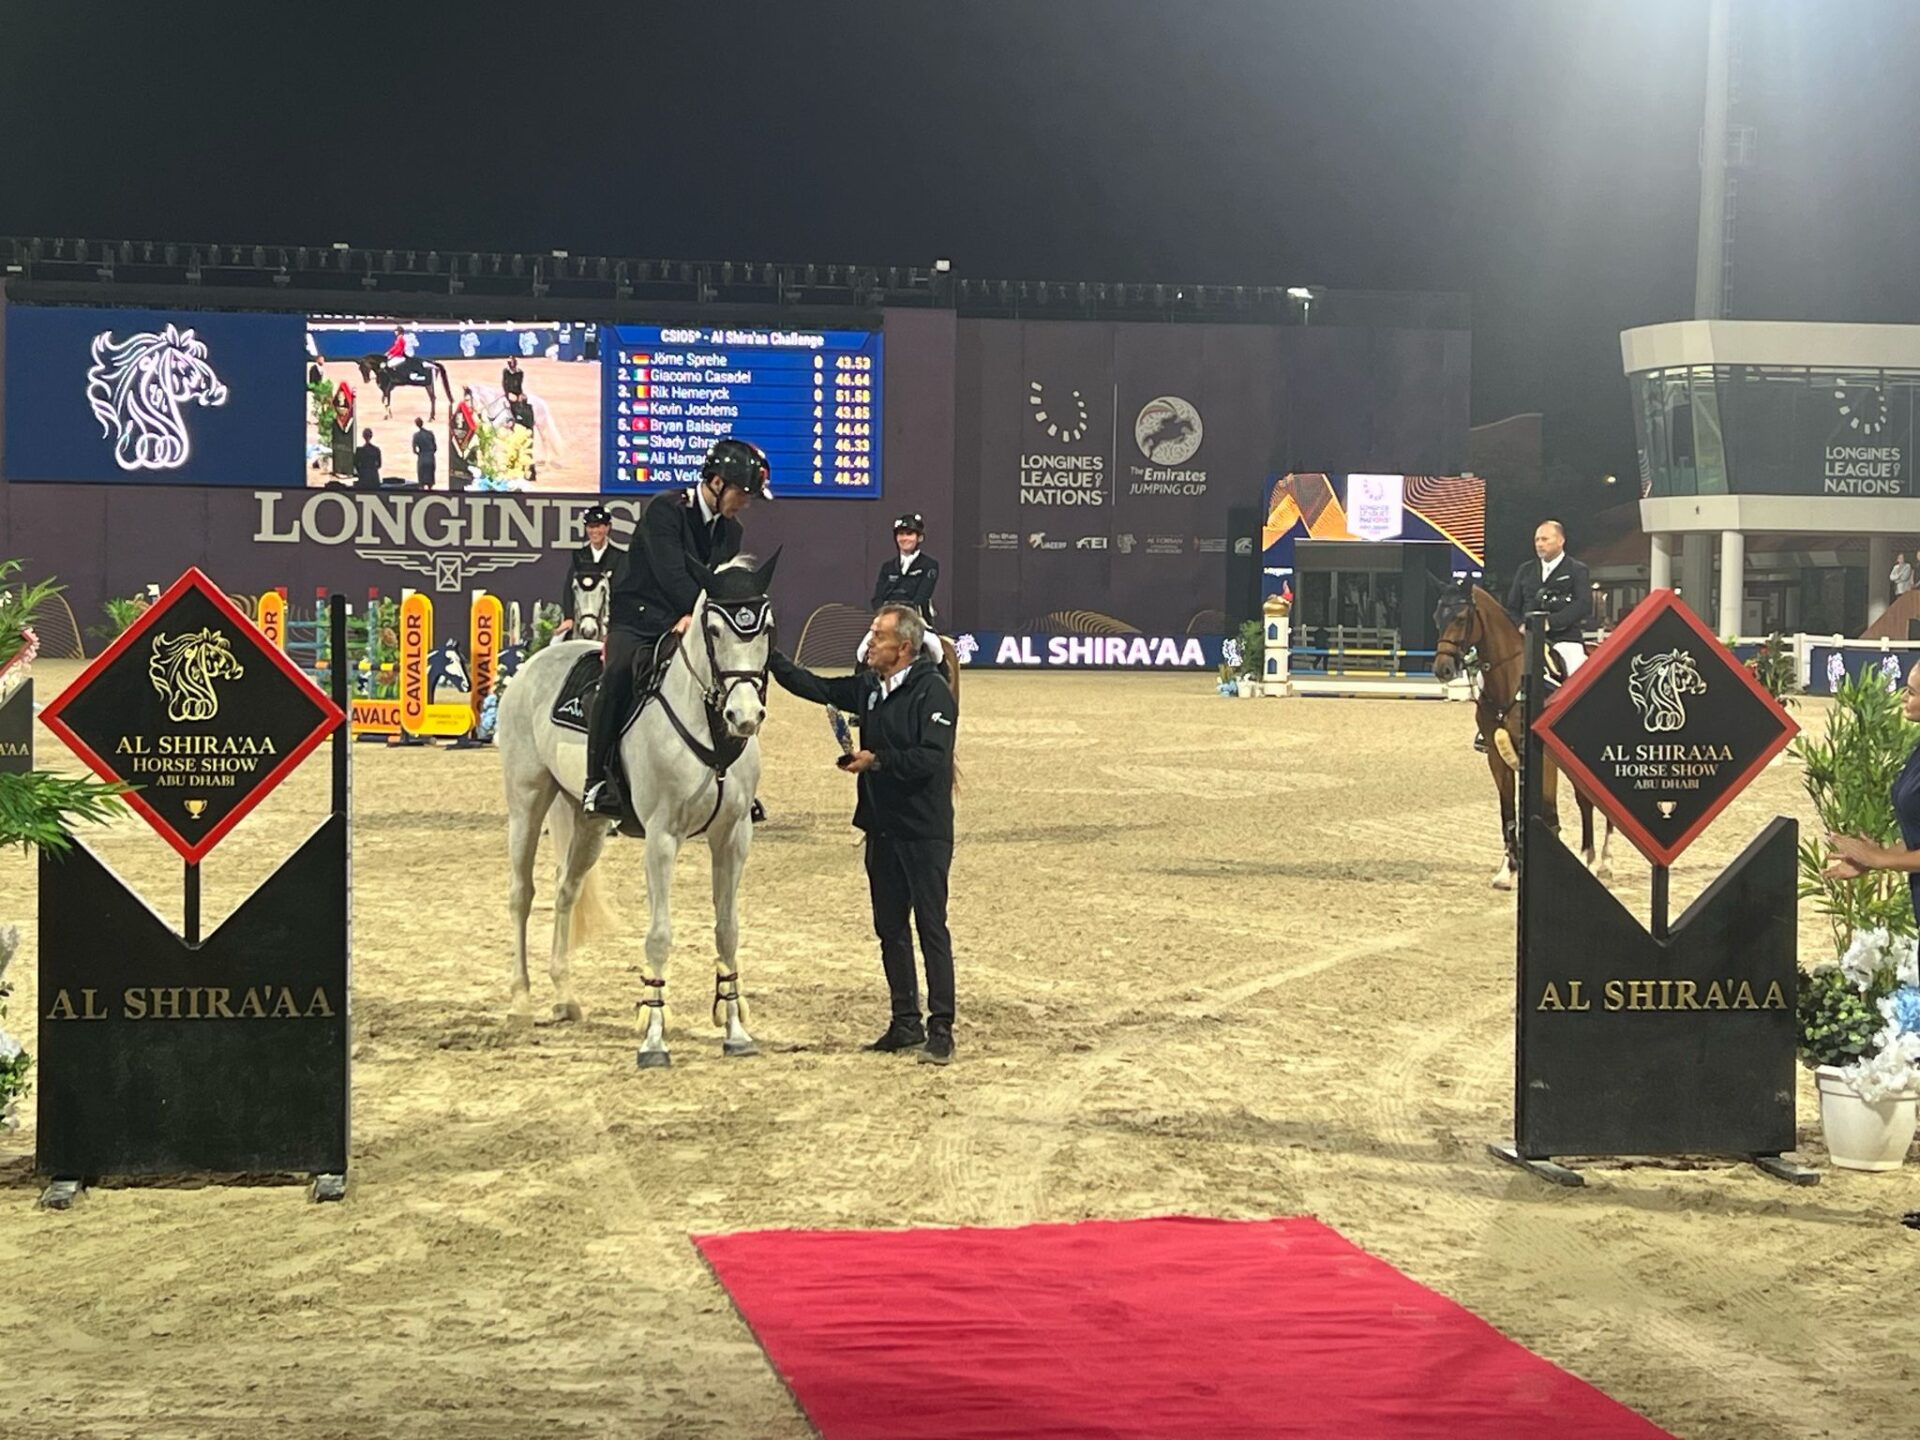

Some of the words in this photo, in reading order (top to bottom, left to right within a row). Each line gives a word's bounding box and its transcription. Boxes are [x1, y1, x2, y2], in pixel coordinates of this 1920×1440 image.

[770, 332, 824, 349] Challenge
[619, 351, 631, 364] 1.
[686, 353, 728, 368] Sprehe
[618, 368, 631, 380] 2.
[650, 369, 702, 382] Giacomo
[618, 385, 631, 398] 3.
[650, 385, 669, 398] Rik
[671, 386, 730, 402] Hemeryck
[618, 401, 631, 414] 4.
[650, 402, 682, 415] Kevin
[685, 402, 738, 417] Jochems
[813, 405, 822, 418] 4
[650, 418, 683, 434] Bryan
[686, 419, 733, 435] Balsiger
[813, 422, 822, 435] 4
[650, 435, 685, 450] Shady
[688, 436, 719, 449] Ghra
[813, 438, 822, 451] 4
[617, 451, 631, 464] 7.
[650, 452, 665, 465] Ali
[813, 454, 822, 468] 4
[1825, 446, 1901, 460] LONGINES
[1020, 454, 1104, 470] LONGINES
[1825, 462, 1892, 477] LEAGUE
[649, 468, 672, 481] Jos
[1020, 471, 1093, 488] LEAGUE
[1144, 468, 1207, 482] Emirates
[1129, 483, 1181, 495] JUMPING
[1183, 484, 1207, 495] CUP
[1823, 479, 1901, 494] NATIONS
[1020, 489, 1104, 506] NATIONS
[253, 491, 641, 553] LONGINES
[995, 635, 1041, 664] AL
[1048, 636, 1206, 667] SHIRA'AA
[407, 614, 421, 716] CAVALOR
[352, 708, 400, 726] AVALO
[115, 736, 151, 755] AL
[158, 735, 277, 755] SHIRA'AA
[1600, 744, 1630, 762] AL
[1635, 744, 1734, 762] SHIRA'AA
[133, 757, 197, 772] HORSE
[200, 757, 259, 772] SHOW
[1614, 764, 1668, 777] HORSE
[1671, 763, 1719, 777] SHOW
[156, 775, 186, 787] ABU
[189, 775, 236, 787] DHABI
[1633, 779, 1659, 790] ABU
[1661, 779, 1700, 790] DHABI
[45, 988, 109, 1021] AL
[123, 985, 336, 1020] SHIRA'AA
[1536, 981, 1592, 1012] AL
[1603, 979, 1789, 1012] SHIRA'AA
